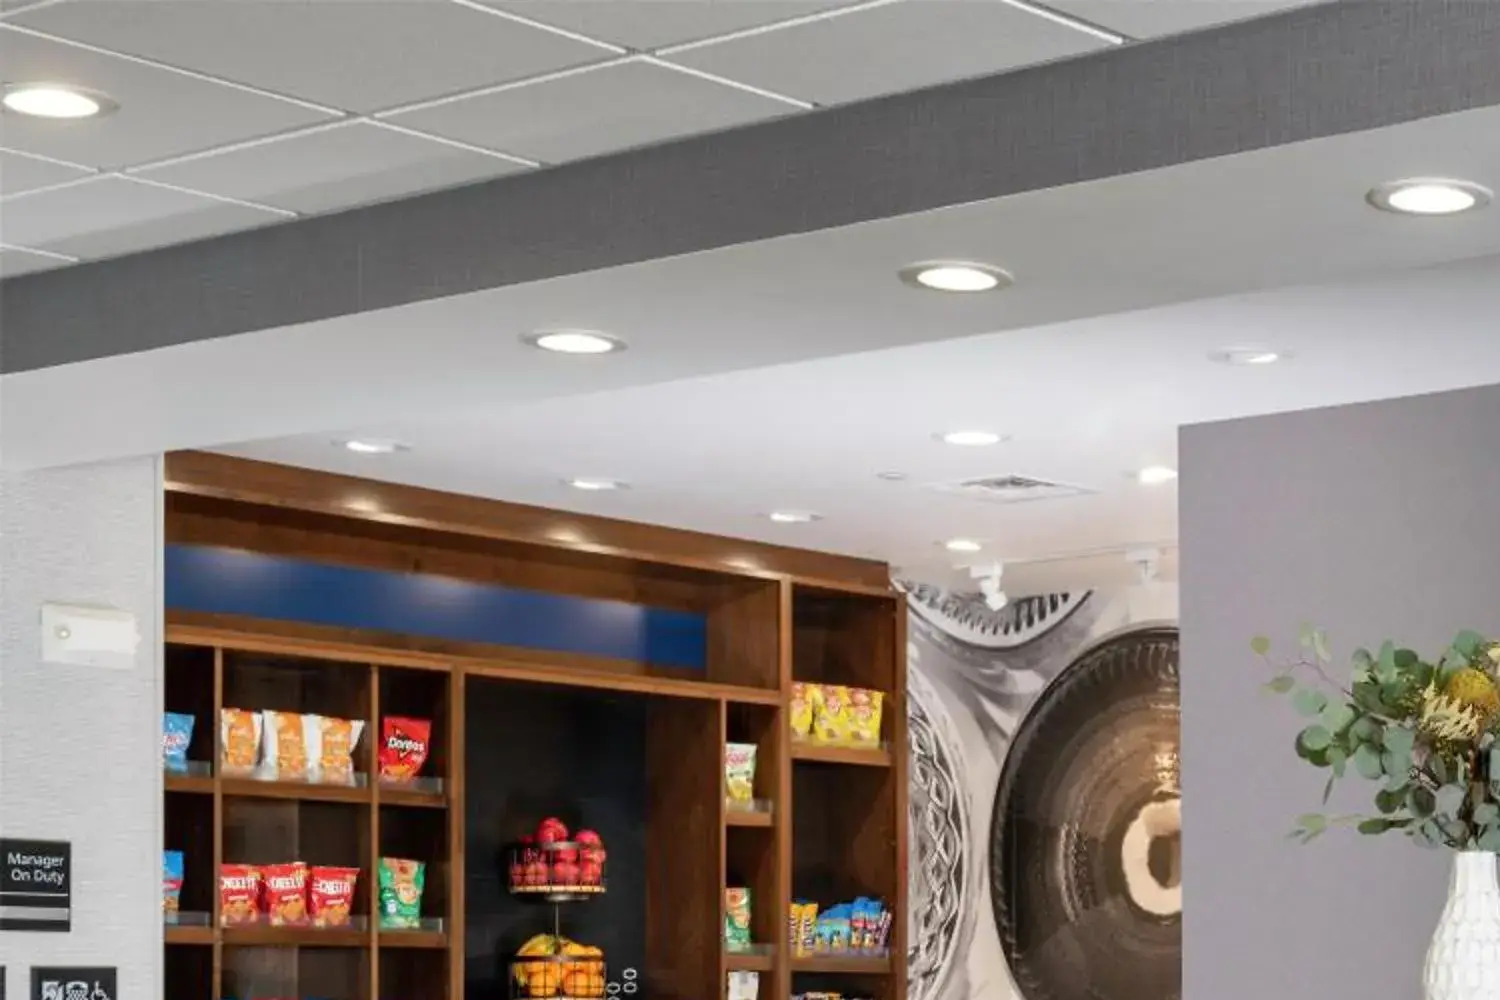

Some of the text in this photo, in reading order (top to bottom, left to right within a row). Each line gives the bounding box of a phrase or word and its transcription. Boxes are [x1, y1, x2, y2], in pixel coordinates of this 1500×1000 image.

[7, 852, 65, 869] Manager
[11, 868, 65, 886] On Duty
